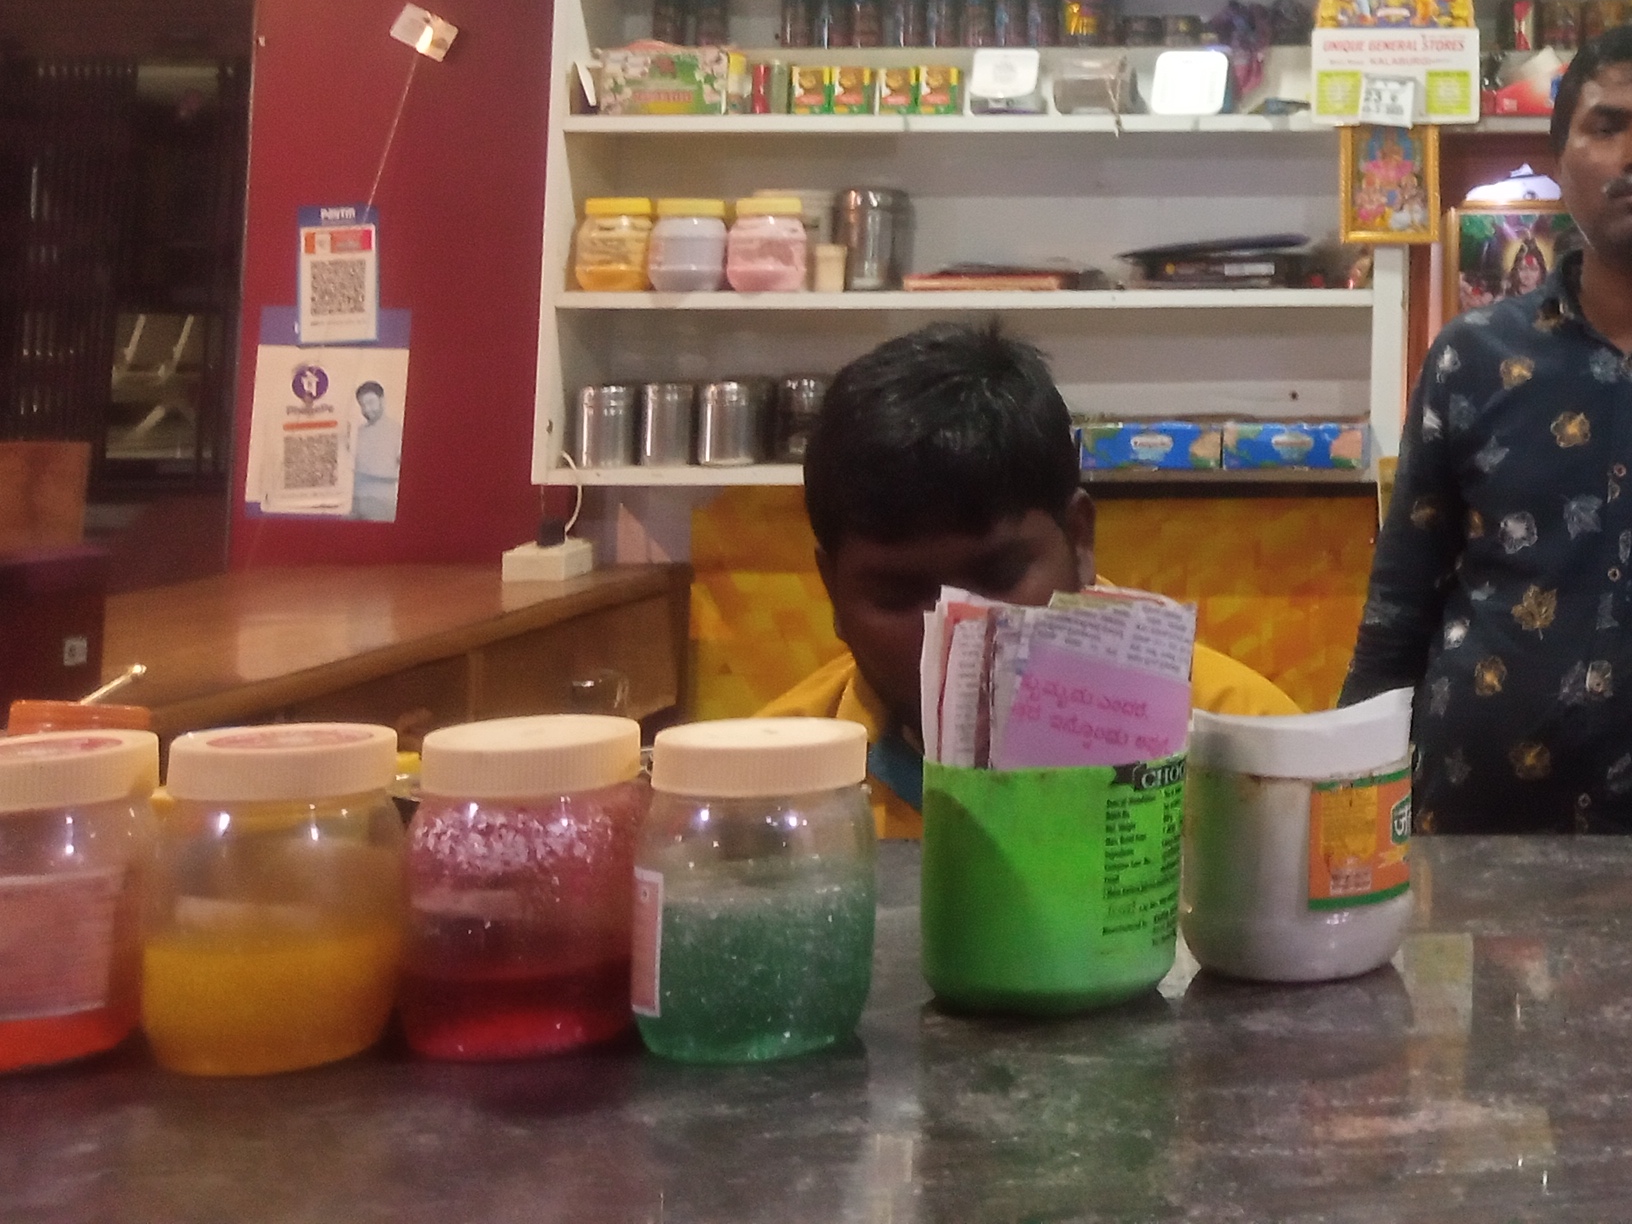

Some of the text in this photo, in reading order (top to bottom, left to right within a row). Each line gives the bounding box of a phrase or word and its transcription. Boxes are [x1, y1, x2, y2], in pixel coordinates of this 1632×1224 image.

[1323, 34, 1466, 53] UNIQUE GENERAL STORES
